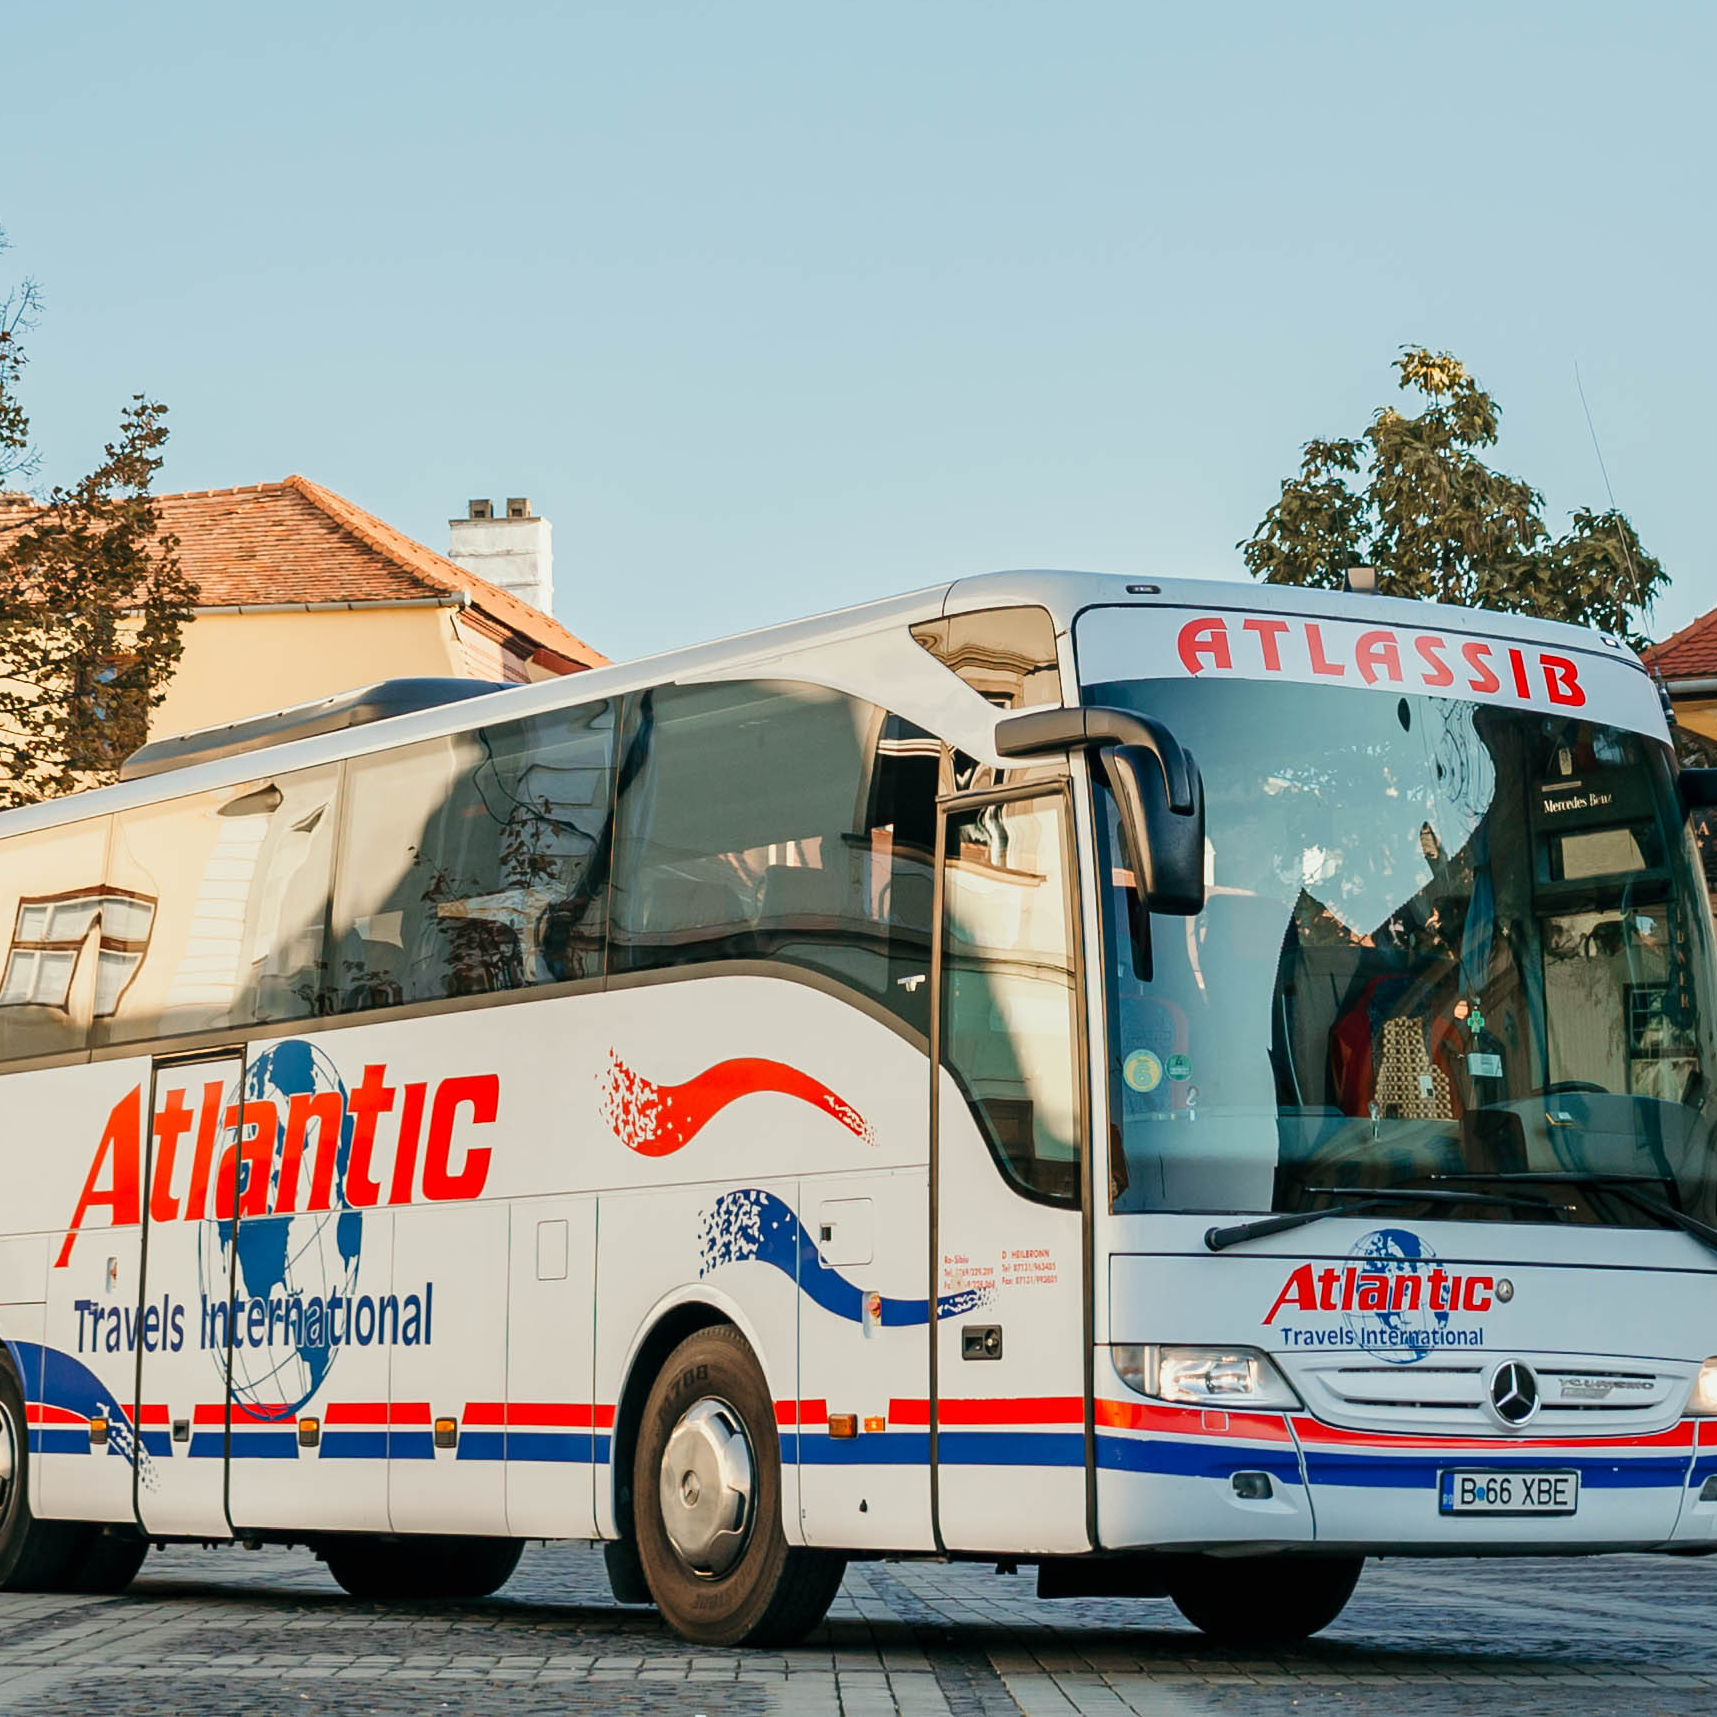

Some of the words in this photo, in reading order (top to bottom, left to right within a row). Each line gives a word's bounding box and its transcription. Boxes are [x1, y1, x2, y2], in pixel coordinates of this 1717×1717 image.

[1177, 617, 1587, 708] ATLASSIB
[1542, 794, 1588, 815] Mercedes
[52, 1063, 501, 1269] Atlantic
[73, 1293, 186, 1354] Travels
[200, 1281, 434, 1351] International
[1261, 1262, 1495, 1325] Atlantic
[1280, 1326, 1354, 1346] Travels
[1361, 1327, 1484, 1347] International
[1461, 1477, 1477, 1505] B
[1485, 1477, 1512, 1505] 66
[1521, 1477, 1569, 1506] XBE
